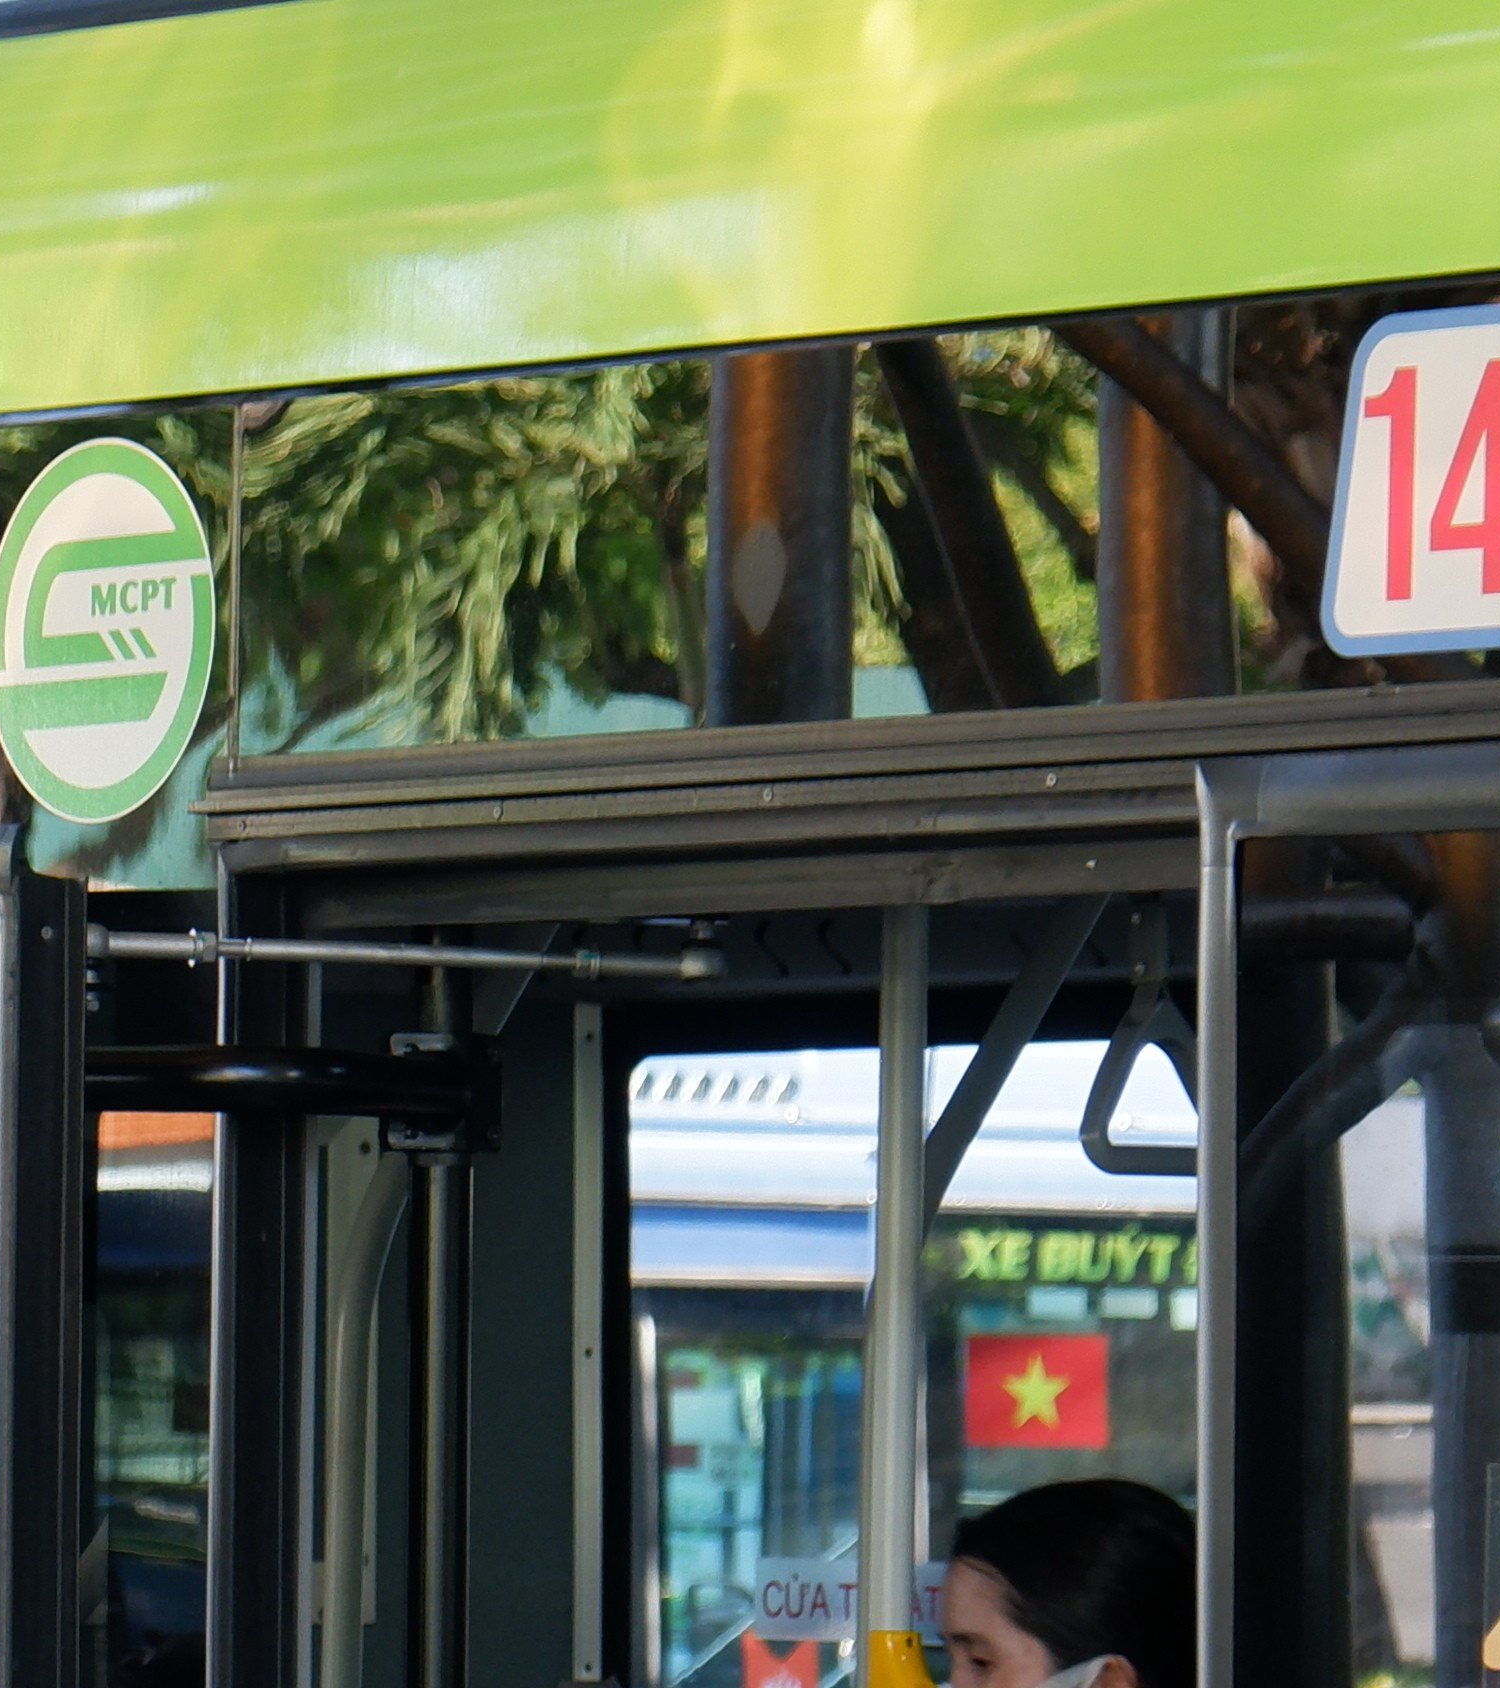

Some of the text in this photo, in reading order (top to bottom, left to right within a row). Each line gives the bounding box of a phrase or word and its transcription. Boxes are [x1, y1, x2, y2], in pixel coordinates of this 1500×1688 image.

[90, 576, 178, 617] MCPT
[956, 1228, 1033, 1281] XE
[762, 1572, 832, 1619] CỬA
